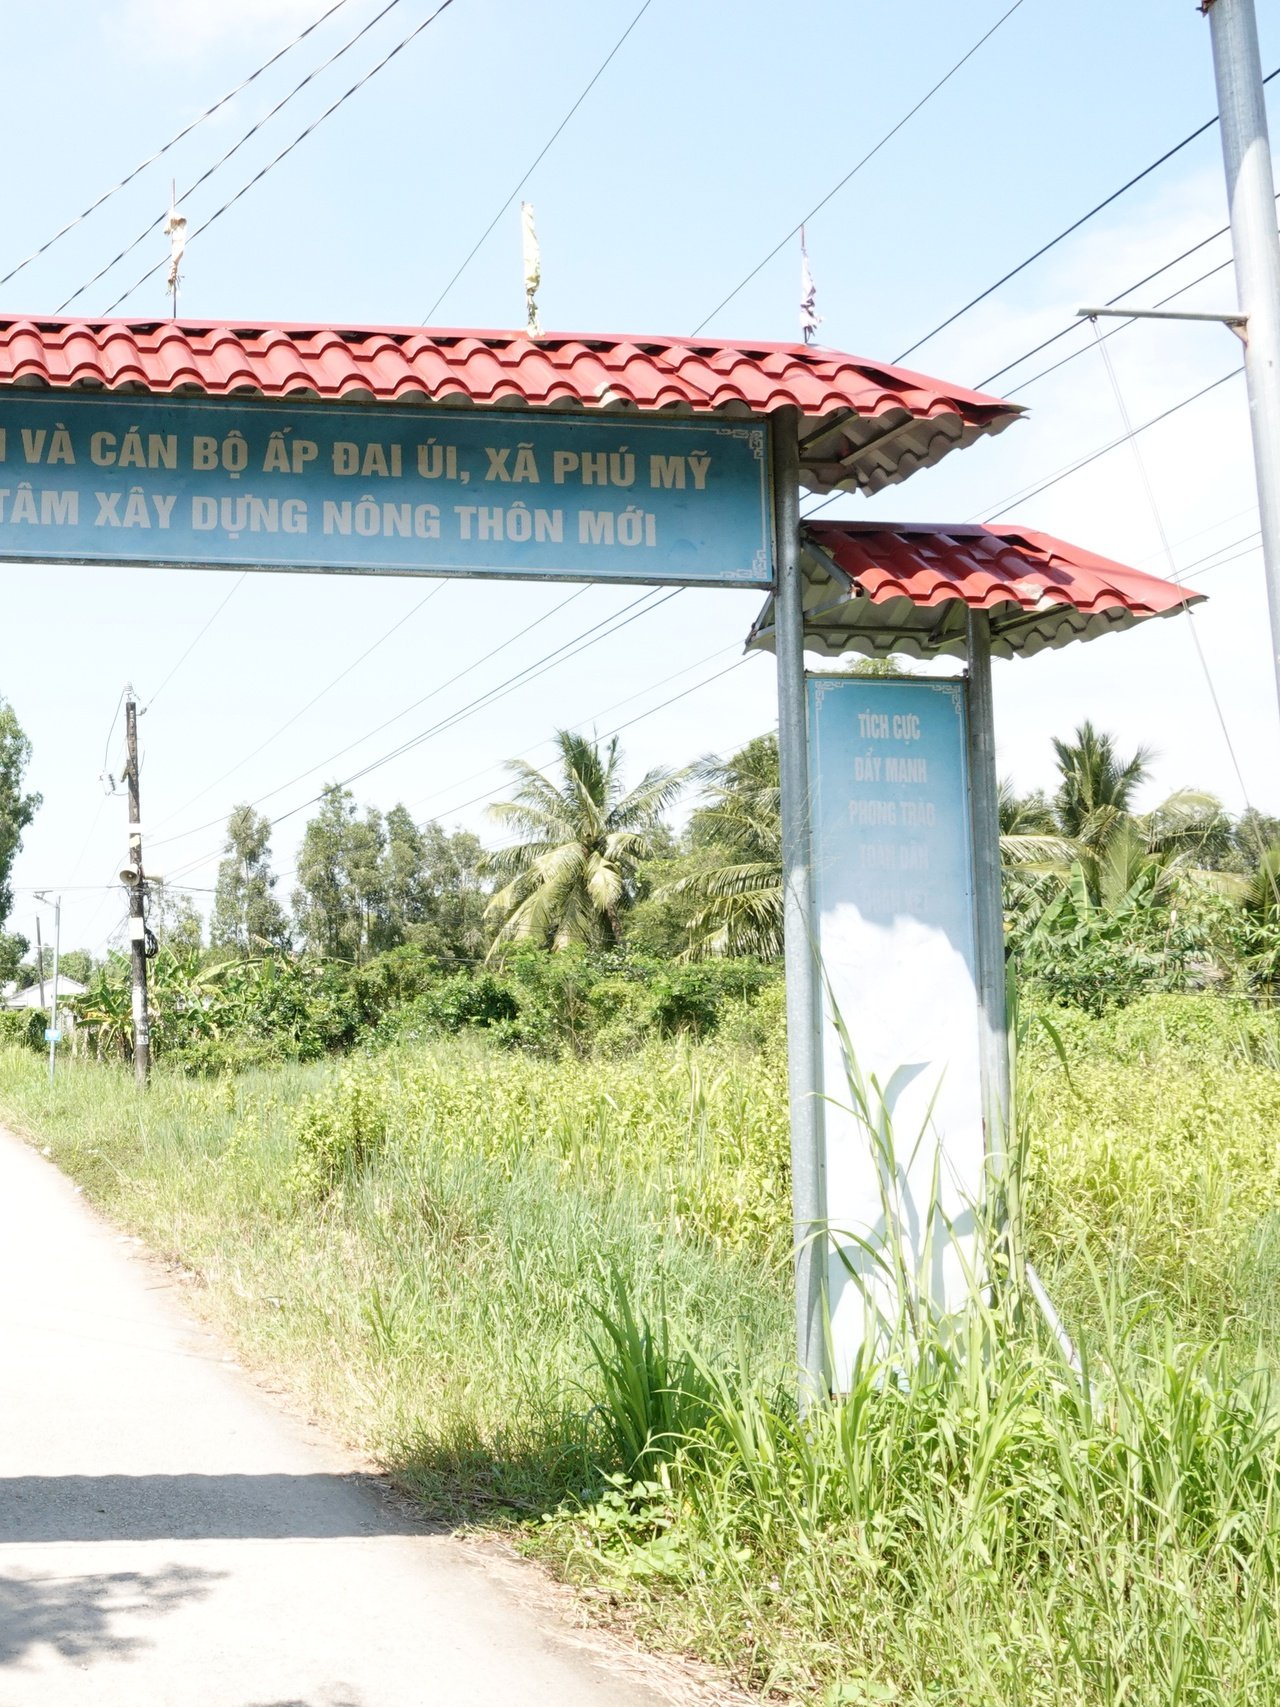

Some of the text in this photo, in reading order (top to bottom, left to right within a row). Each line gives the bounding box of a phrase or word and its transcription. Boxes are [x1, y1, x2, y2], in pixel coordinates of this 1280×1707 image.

[21, 423, 75, 464] VÀ
[91, 426, 177, 469] CÁN
[193, 430, 248, 479] BỘ
[262, 427, 318, 473] ẤP
[332, 442, 402, 477] ĐAI
[418, 438, 470, 484] ÚI,
[485, 442, 540, 483] XÃ
[554, 446, 635, 487] PHÚ
[650, 450, 712, 490] MỸ
[94, 486, 177, 529] XÂY
[192, 494, 308, 539] DỰNG
[323, 494, 440, 539] NÔNG
[454, 501, 563, 543] THÔN
[578, 505, 657, 547] MỚI
[857, 708, 921, 745] TÍCH CỰC
[854, 747, 927, 788] ĐẨY MẠNH
